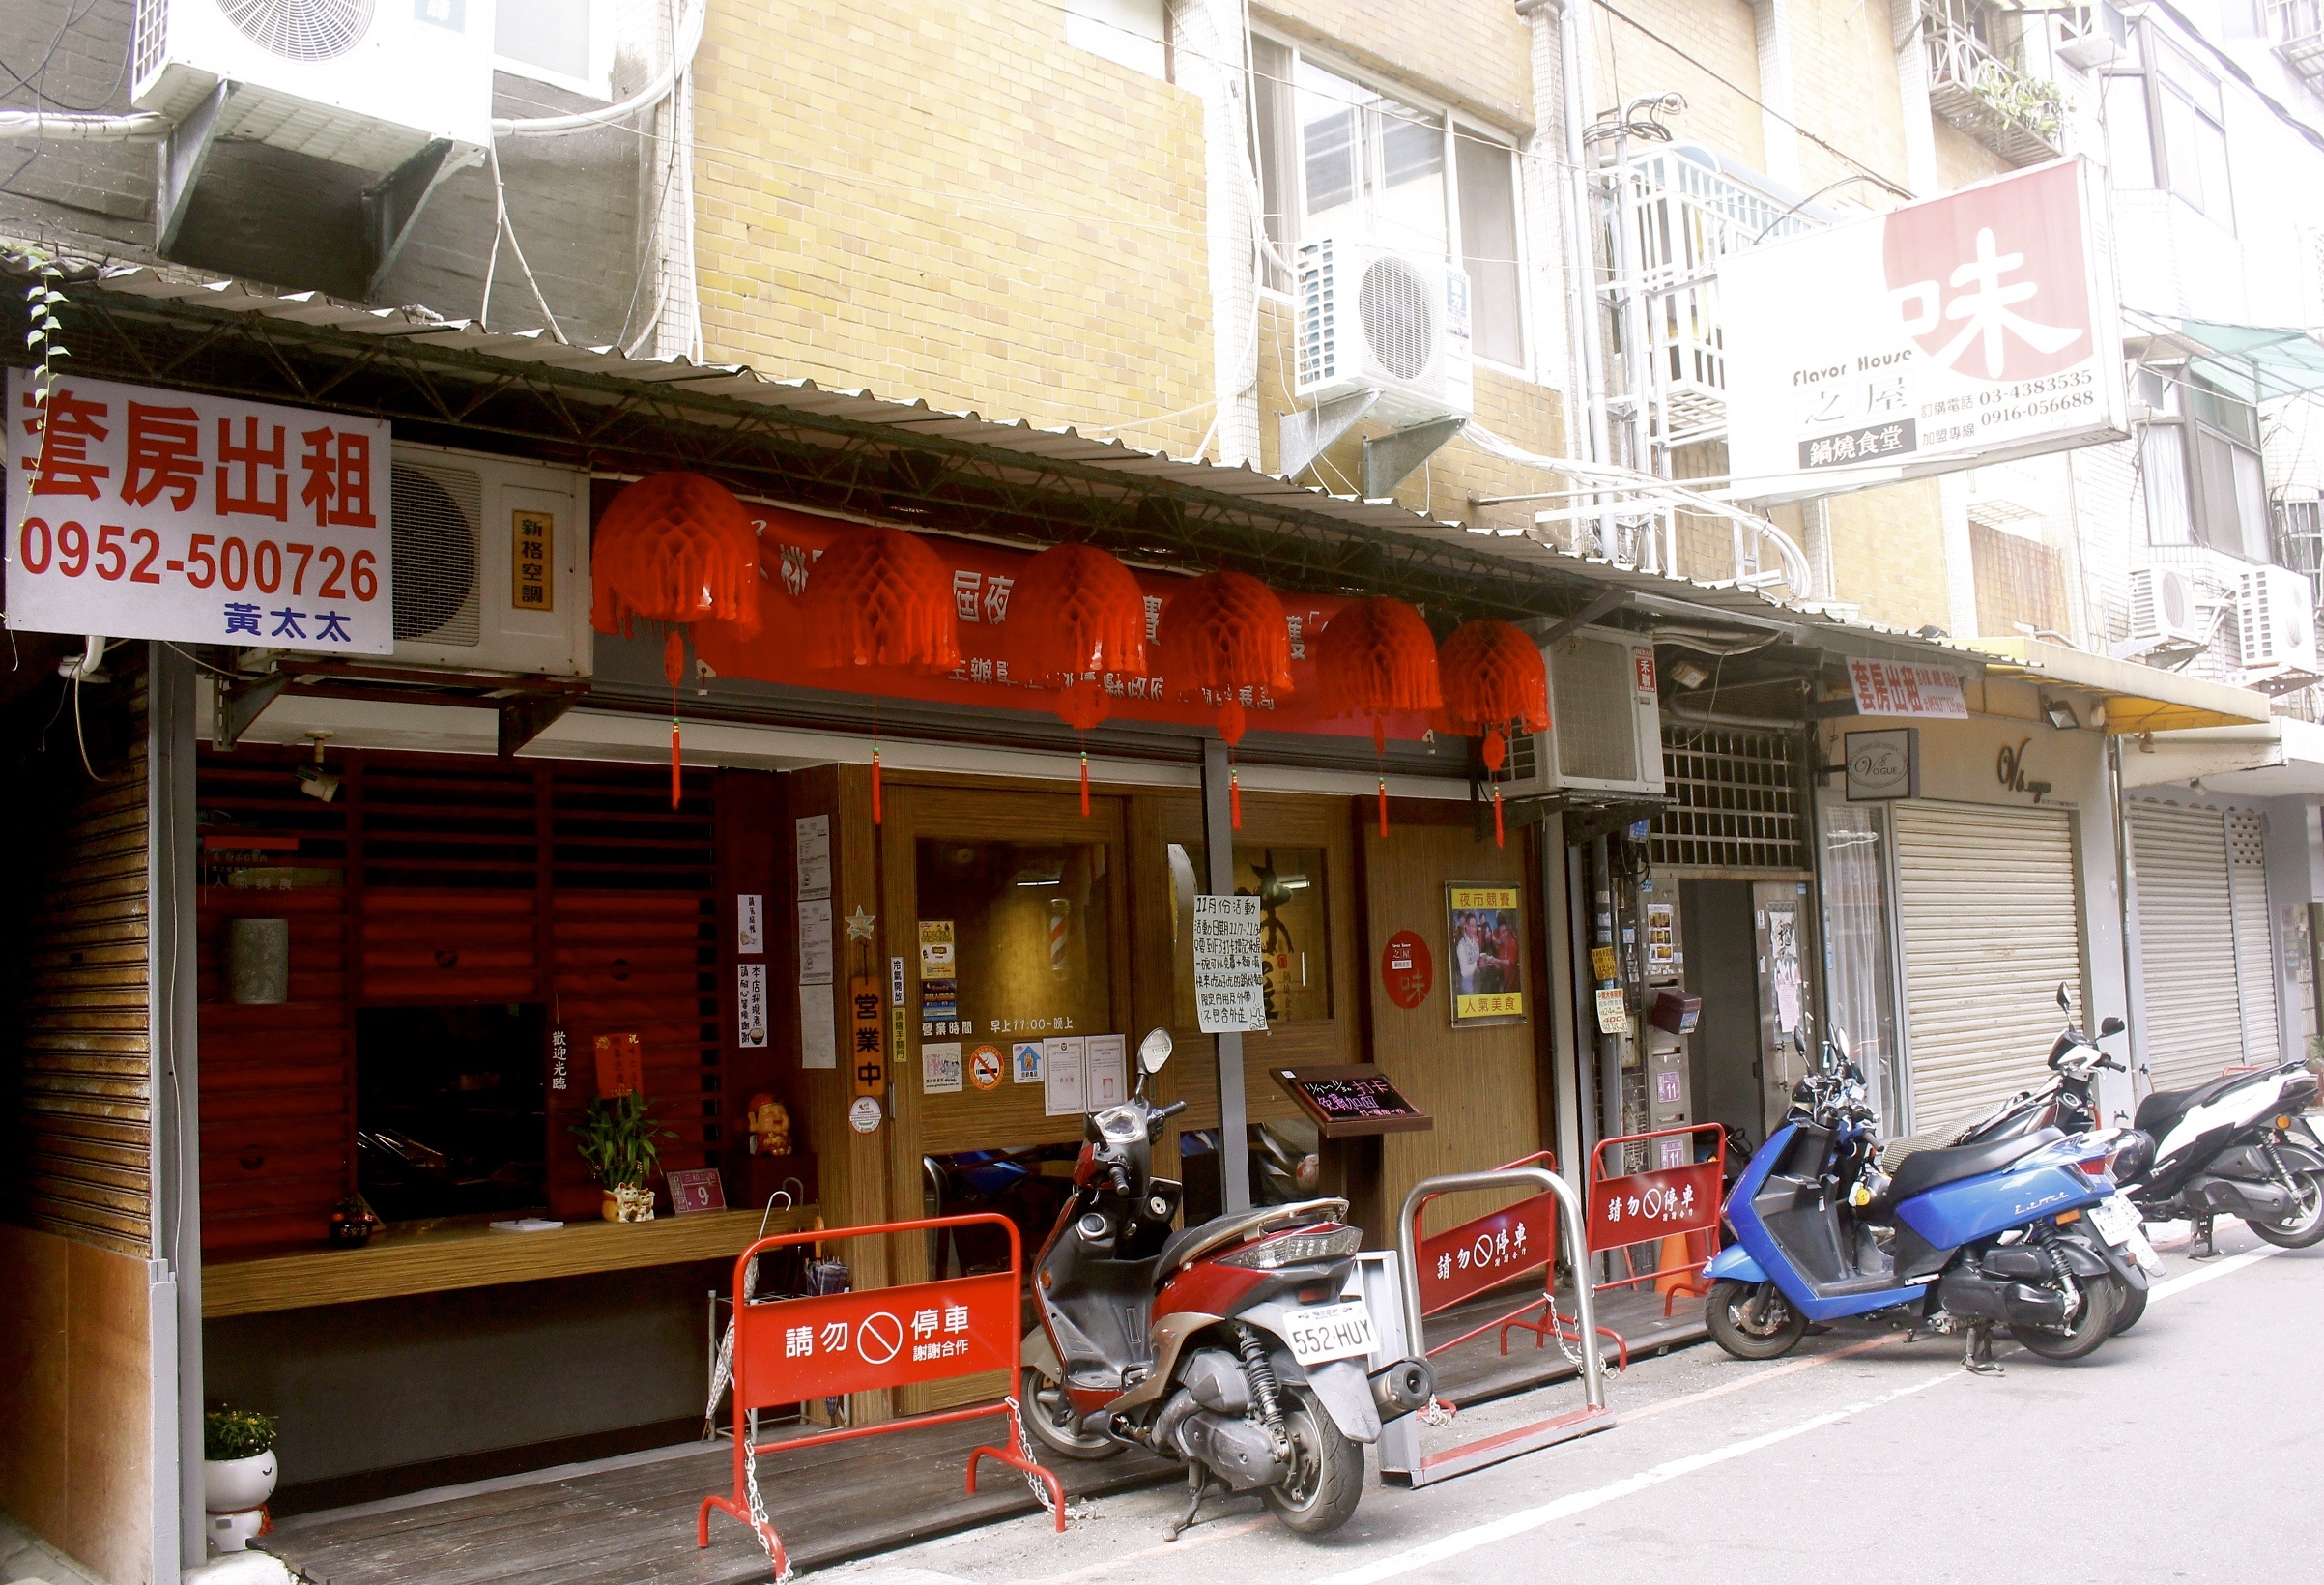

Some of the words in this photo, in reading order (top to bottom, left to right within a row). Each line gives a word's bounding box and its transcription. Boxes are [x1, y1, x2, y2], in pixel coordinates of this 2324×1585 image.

[1888, 226, 2083, 379] 味
[1793, 362, 1847, 387] Flavor
[1858, 348, 1912, 372] House
[1804, 377, 1908, 425] 之屋
[1920, 395, 1973, 418] 訂購電話
[1979, 369, 2093, 407] 03-4383535
[1922, 423, 1975, 447] 加盟專線
[1981, 390, 2094, 427] 0916-056688
[21, 389, 377, 529] 套房出租
[1809, 425, 1904, 468] 鍋燒食堂
[20, 517, 378, 602] 0952-500726
[520, 518, 544, 605] 新格空調
[223, 602, 352, 643] 黃太太
[1851, 661, 1924, 713] 套房出租
[1196, 897, 1256, 915] 11月份活動
[1459, 892, 1510, 907] 夜市競賽
[1465, 996, 1515, 1014] 人氣美食
[922, 1021, 973, 1037] 營業時間
[552, 1031, 567, 1090] 歡迎光臨
[1666, 1082, 1677, 1099] 11
[698, 1186, 709, 1206] 9
[1607, 1195, 1640, 1223] 請勿
[1663, 1183, 1695, 1211] 停車
[1437, 1247, 1470, 1280] 請勿
[1495, 1222, 1527, 1256] 停車
[785, 1321, 849, 1358] 請勿
[910, 1305, 969, 1340] 停車
[912, 1339, 969, 1362] 謝謝合作
